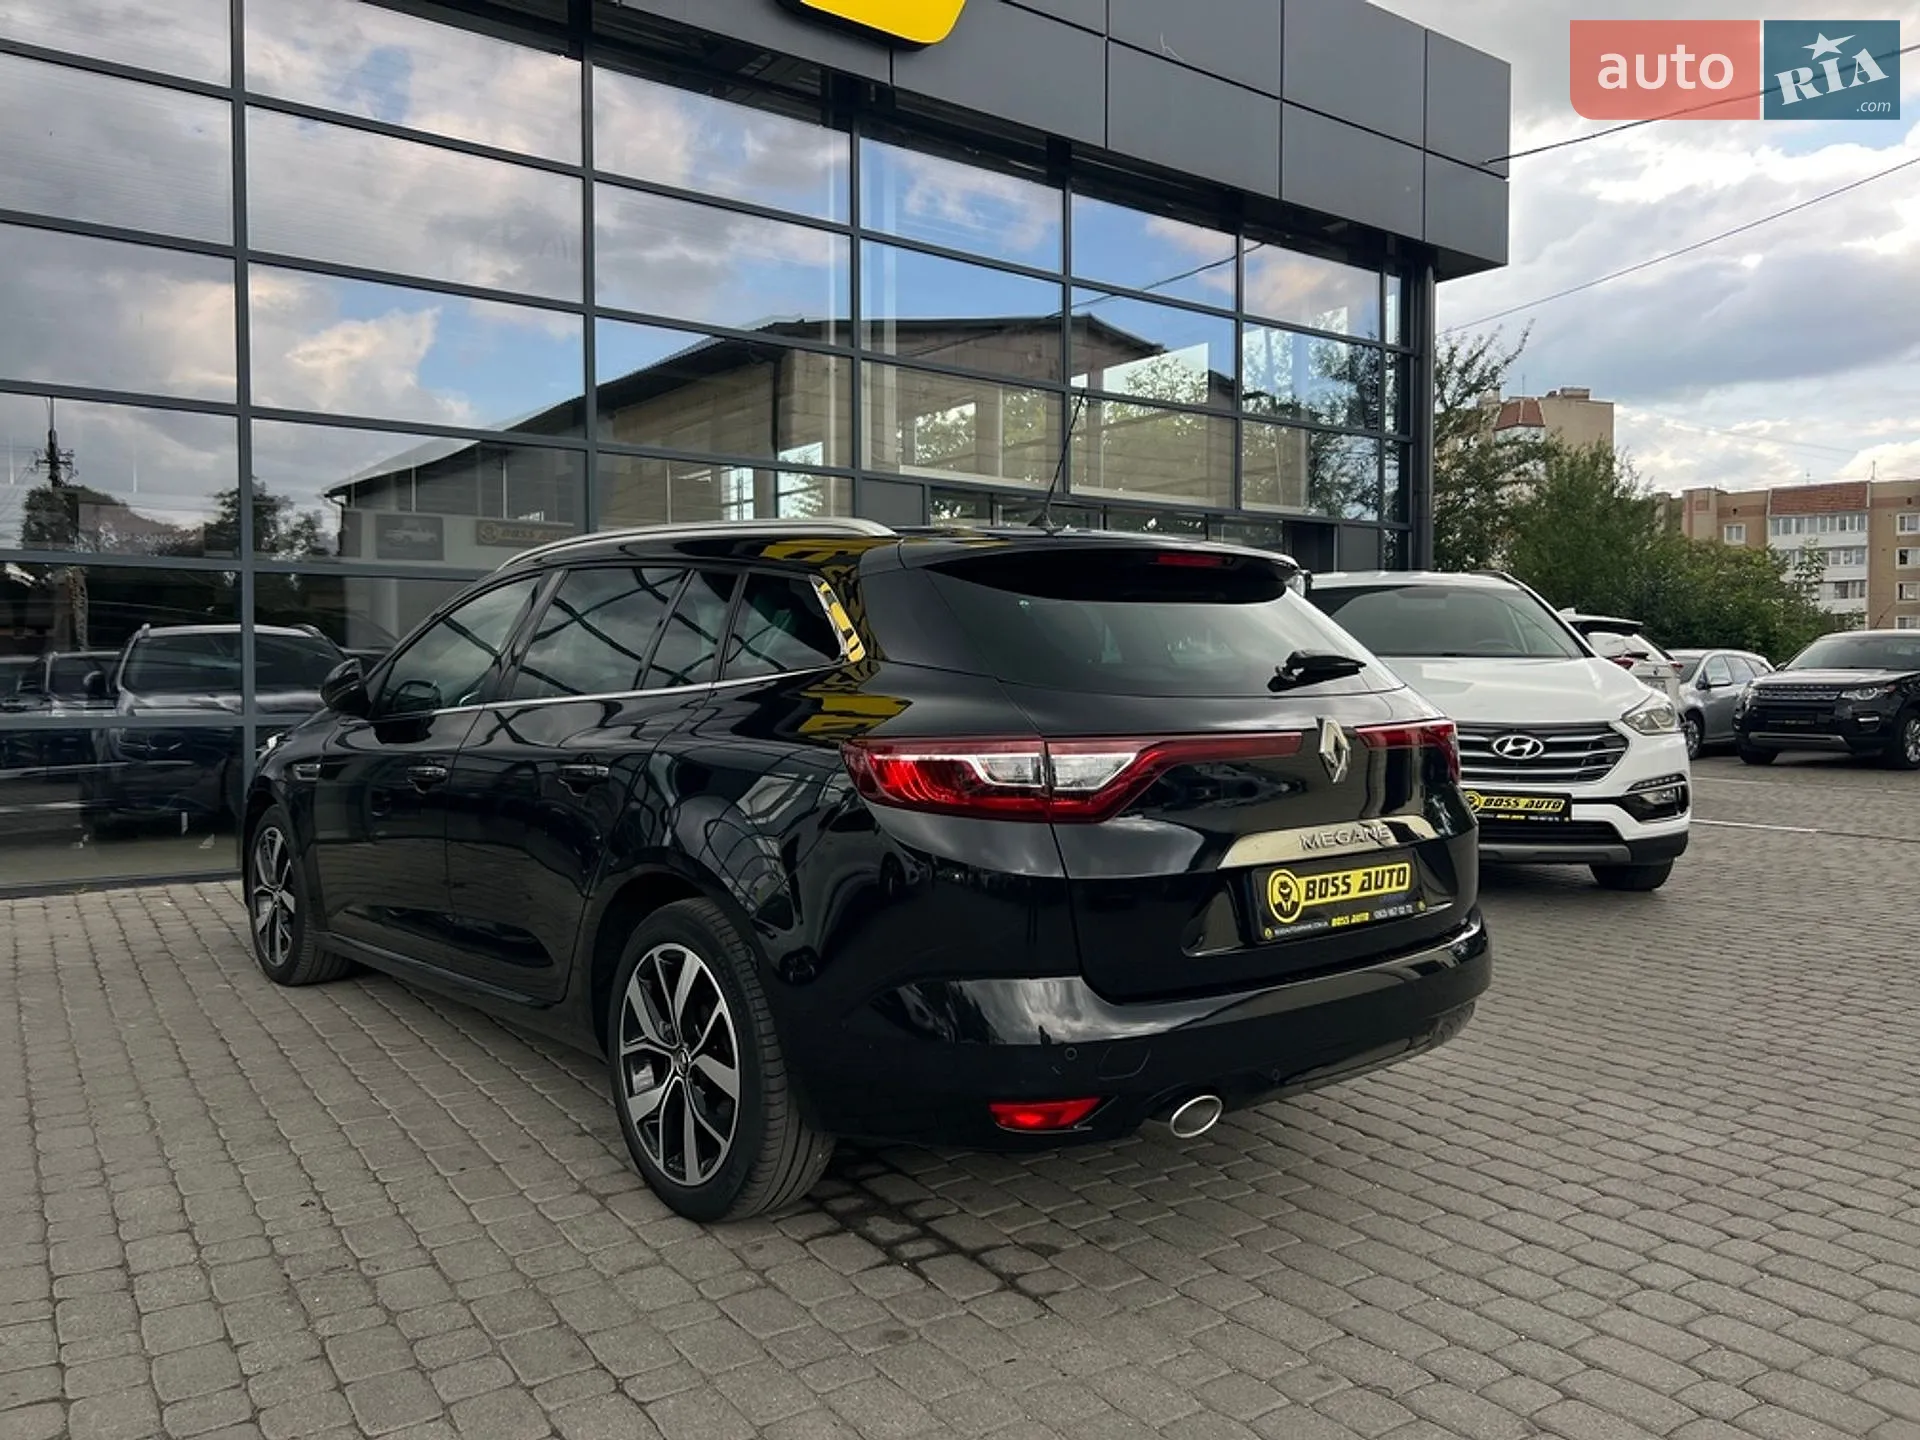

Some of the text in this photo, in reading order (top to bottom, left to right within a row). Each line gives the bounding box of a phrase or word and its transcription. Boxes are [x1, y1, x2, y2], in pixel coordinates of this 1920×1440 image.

[1484, 797, 1563, 809] BOSS AUTO
[1299, 825, 1392, 851] MEGANE
[1304, 866, 1409, 902] BOSS AUTO
